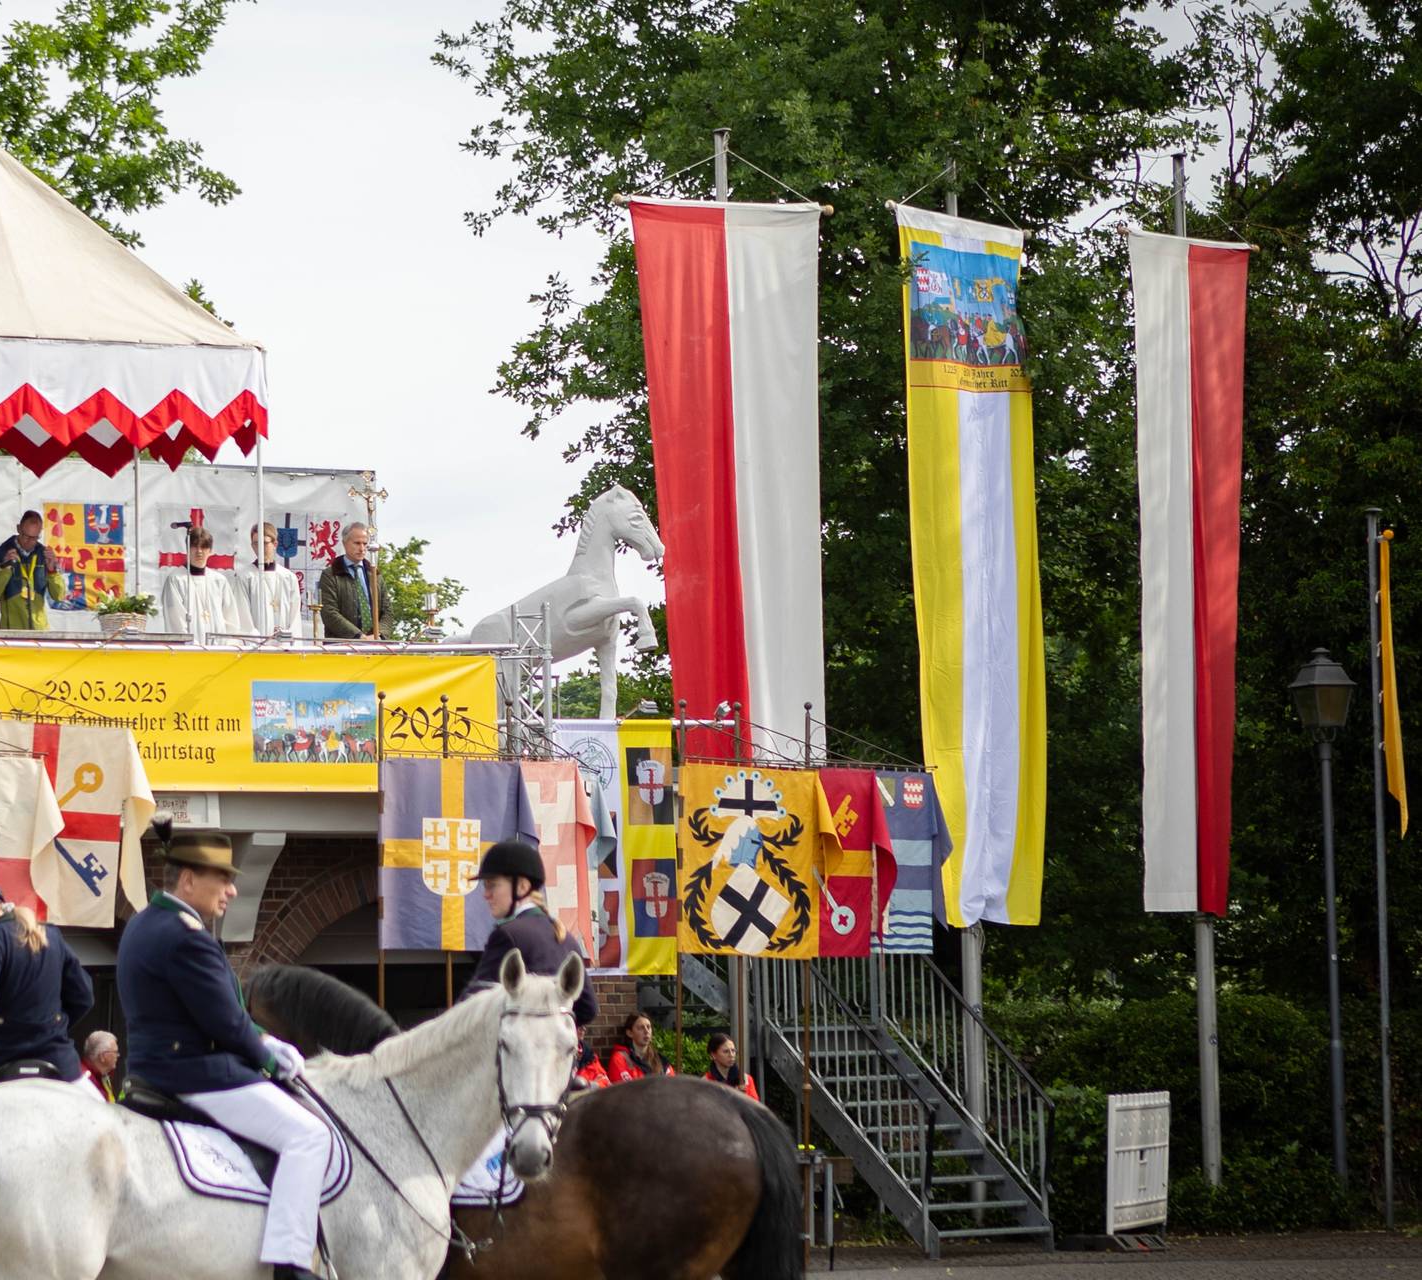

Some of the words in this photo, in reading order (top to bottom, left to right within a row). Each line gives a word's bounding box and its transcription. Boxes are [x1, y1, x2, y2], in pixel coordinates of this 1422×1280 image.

[44, 680, 168, 703] 29.05.2025
[172, 711, 210, 733] Ritt
[215, 715, 242, 732] am
[390, 706, 471, 739] 2025
